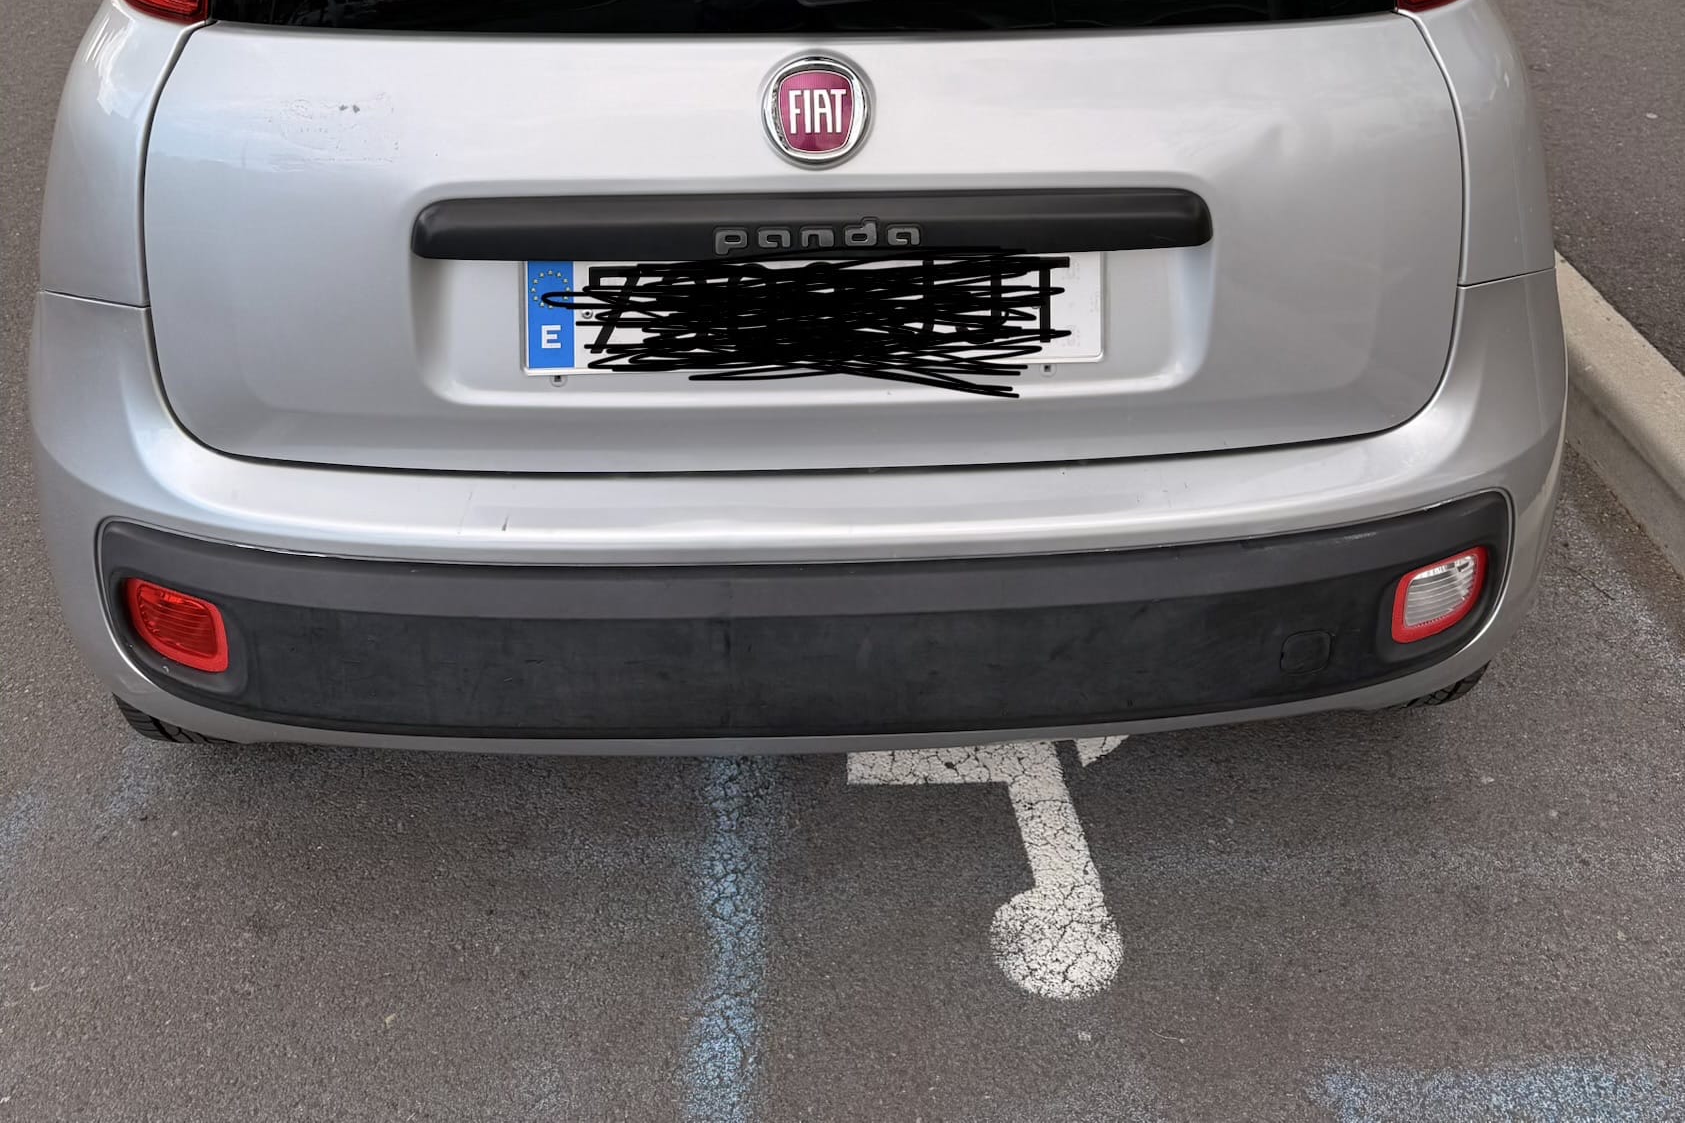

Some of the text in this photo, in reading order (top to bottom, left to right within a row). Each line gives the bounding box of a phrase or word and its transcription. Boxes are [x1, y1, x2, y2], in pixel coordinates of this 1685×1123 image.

[788, 88, 847, 135] FIAT
[714, 218, 921, 255] panda
[541, 324, 562, 349] E
